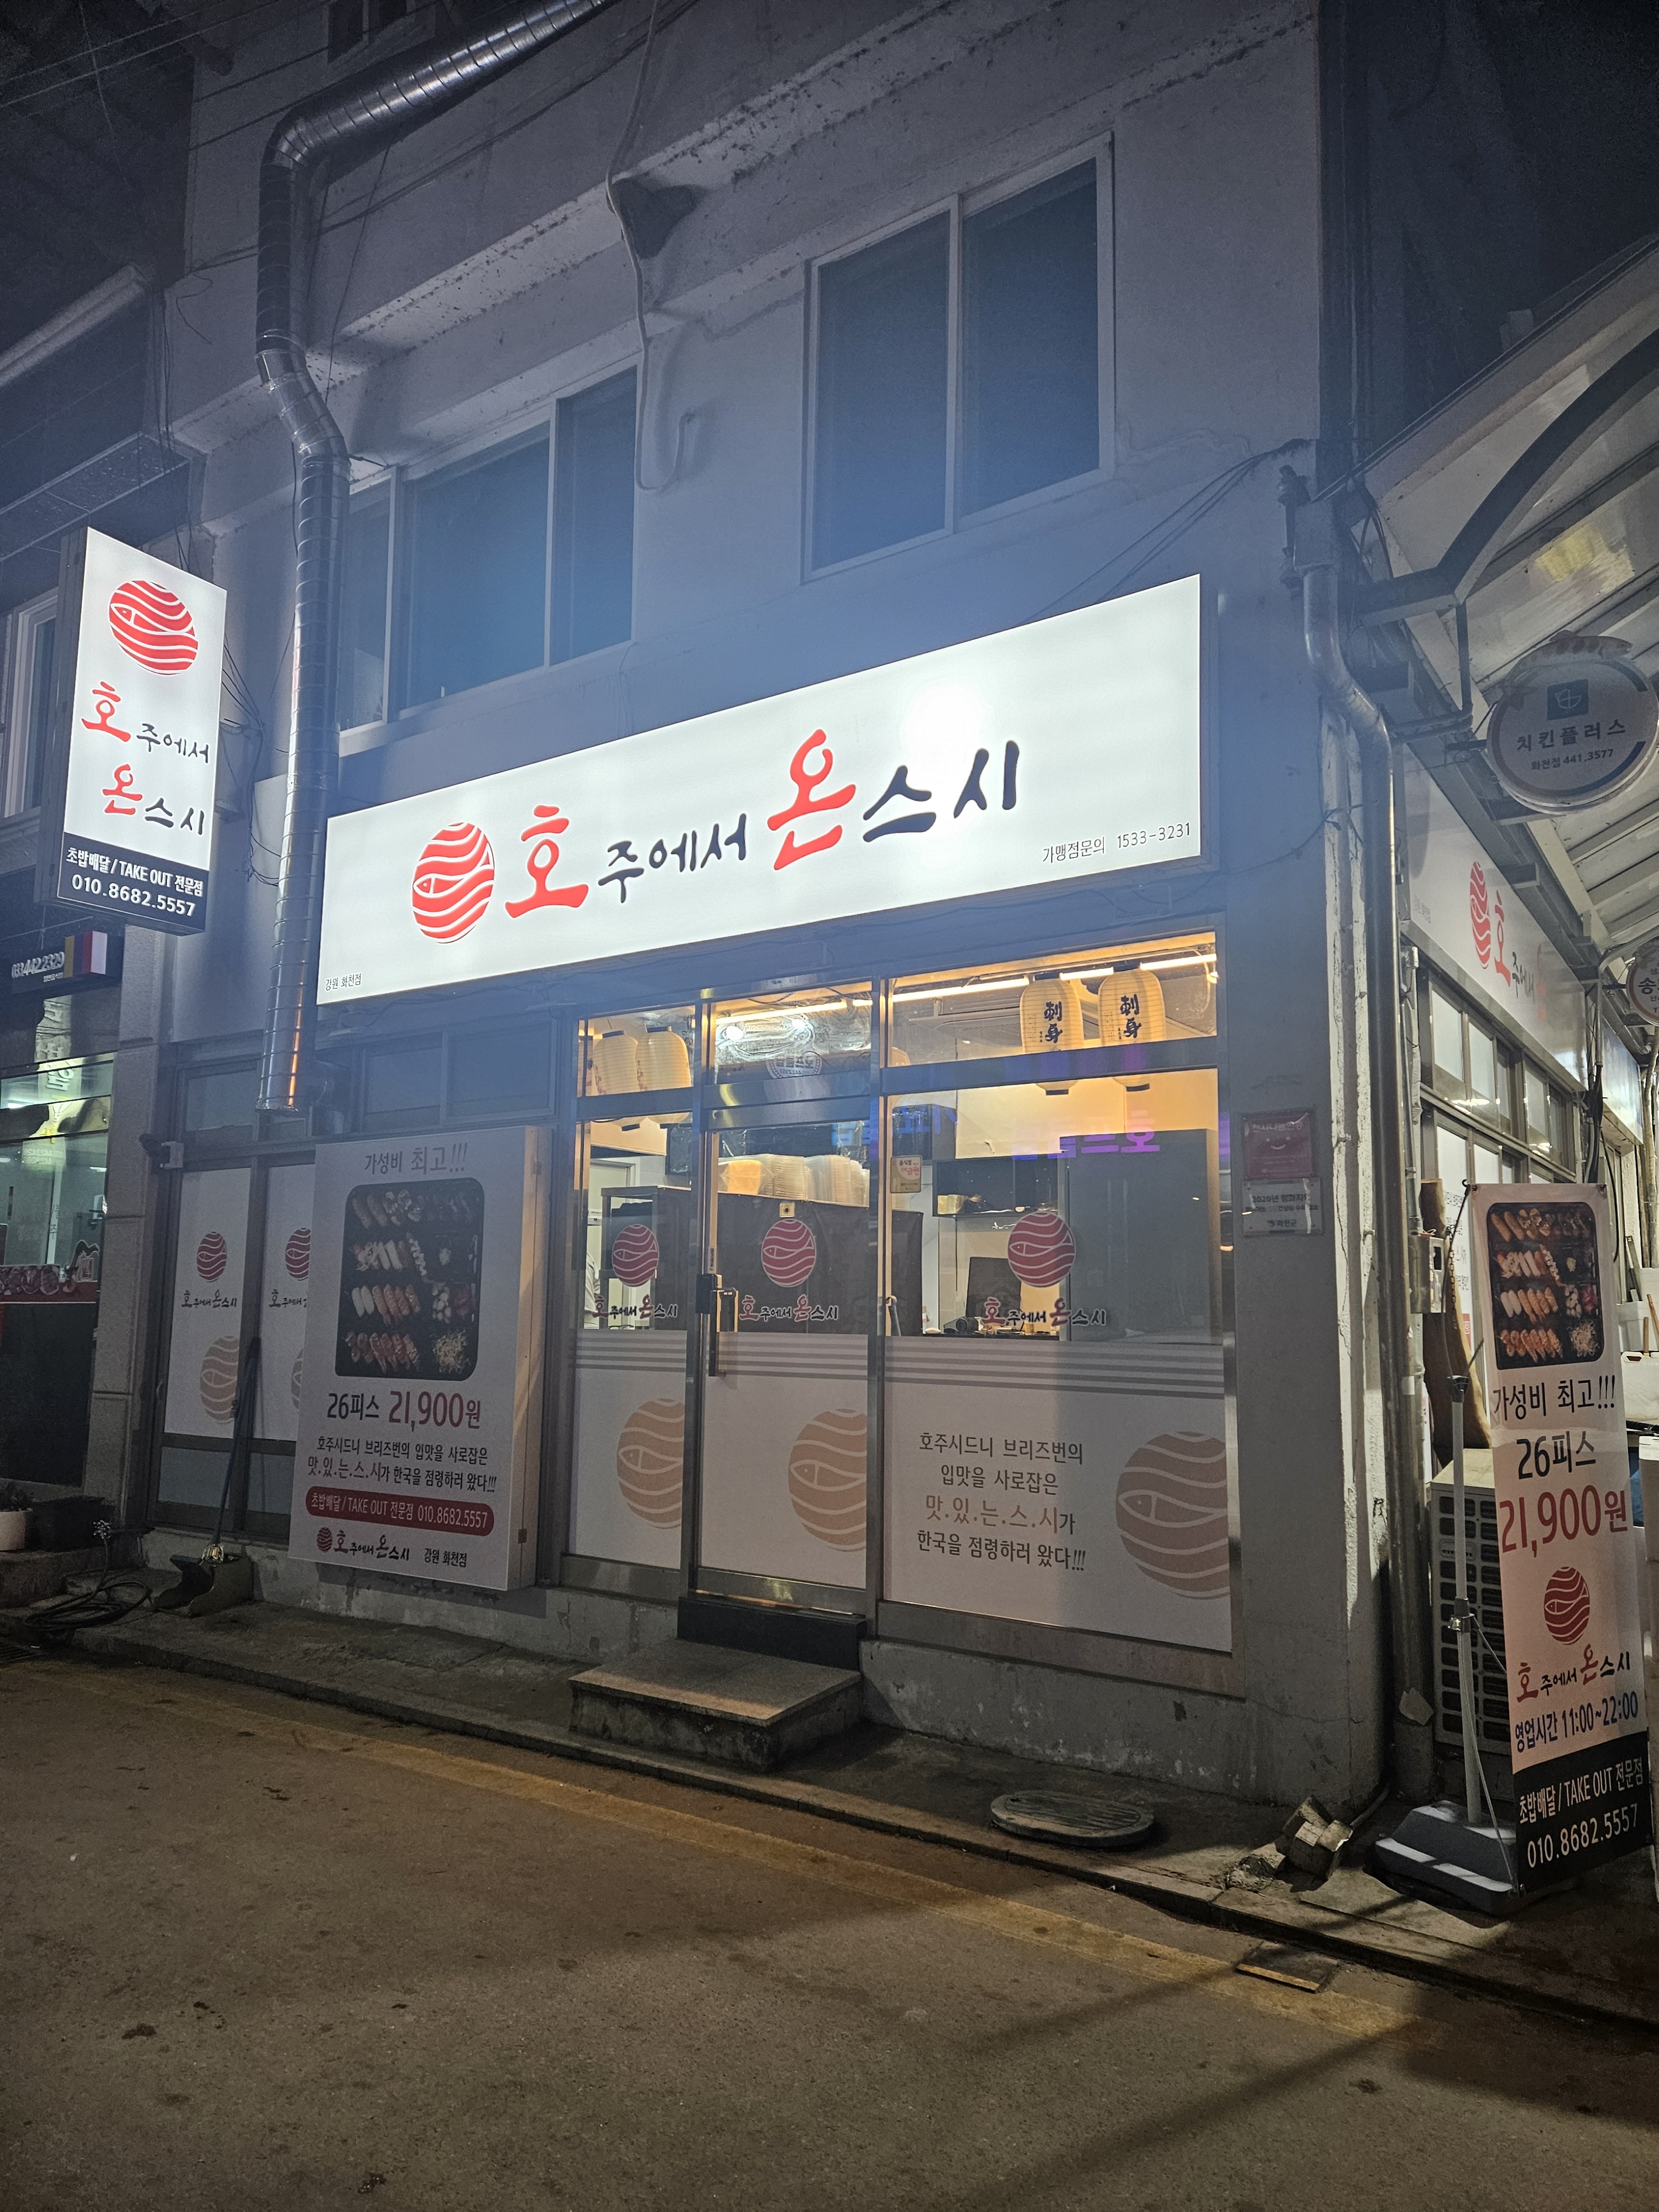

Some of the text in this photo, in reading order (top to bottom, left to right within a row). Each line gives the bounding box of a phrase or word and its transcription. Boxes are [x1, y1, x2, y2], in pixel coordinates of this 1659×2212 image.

[1516, 719, 1626, 752] 치킨플러스
[1530, 748, 1614, 770] 화천점 441.3577
[1042, 822, 1191, 863] 가맹점문의 1533-3231
[71, 874, 196, 917] 010.8682.5557
[119, 860, 149, 882] TAKE
[149, 869, 174, 888] OUT
[174, 874, 204, 898] 전문점
[325, 973, 362, 991] 강원 화천점
[364, 1142, 468, 1175] 가성비 최고!!!
[327, 1391, 481, 1432] 26피스 21,900원
[1493, 1375, 1615, 1421] 가성비 최고!!!
[317, 1436, 488, 1465] 호주시드니 브리즈번의 입맛을 사로잡은
[919, 1432, 1083, 1465] 호주시드니 브리즈번의
[1516, 1431, 1597, 1480] 26피스
[393, 1465, 421, 1485] 한국을
[425, 1469, 463, 1490] 점령하러
[466, 1472, 497, 1493] 왔다!!!
[941, 1464, 1058, 1495] 입맛을 사로잡은
[311, 1493, 341, 1512] 초밥배달
[348, 1496, 368, 1514] TAKE
[370, 1500, 388, 1515] OUT
[390, 1500, 414, 1520] 전문점
[418, 1504, 488, 1528] 010.8682.5557
[1499, 1485, 1628, 1558] 21,900원
[424, 1548, 440, 1564] 강원
[442, 1551, 467, 1568] 화천점
[916, 1529, 1086, 1571] 한국을 점령하러 왔다!!!
[1515, 1691, 1639, 1753] 영업시간 11:00~22:00
[1520, 1785, 1556, 1824] 초밥배달
[1564, 1775, 1592, 1807] TAKE
[1593, 1767, 1613, 1797] OUT
[1615, 1756, 1644, 1792] 전문점
[1527, 1803, 1638, 1868] 010.8682.5557
